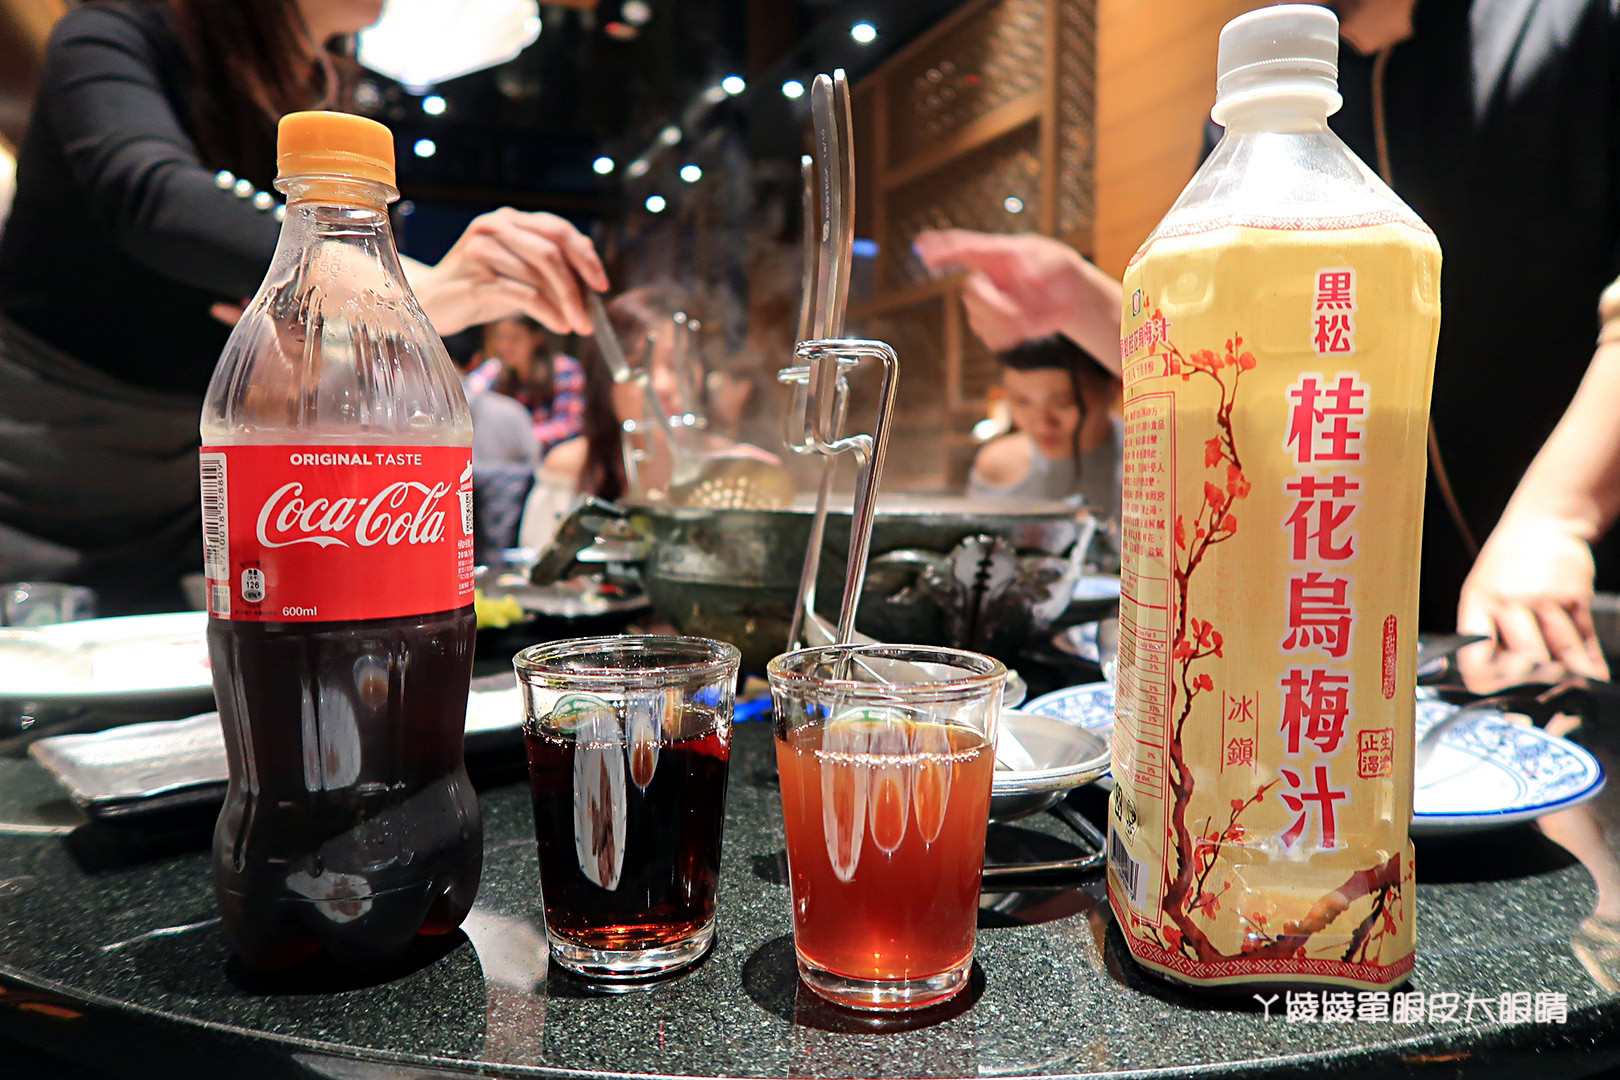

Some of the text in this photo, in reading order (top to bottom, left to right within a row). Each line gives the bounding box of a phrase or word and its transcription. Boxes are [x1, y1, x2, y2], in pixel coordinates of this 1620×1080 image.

[1314, 272, 1353, 352] 黑松
[290, 453, 422, 466] ORIGINAL TASTE
[256, 481, 452, 548] Coca-Cola
[246, 581, 260, 589] 126
[282, 606, 318, 617] 600ml
[1280, 377, 1365, 849] 桂花烏梅汁
[1226, 695, 1254, 767] 冰鎮
